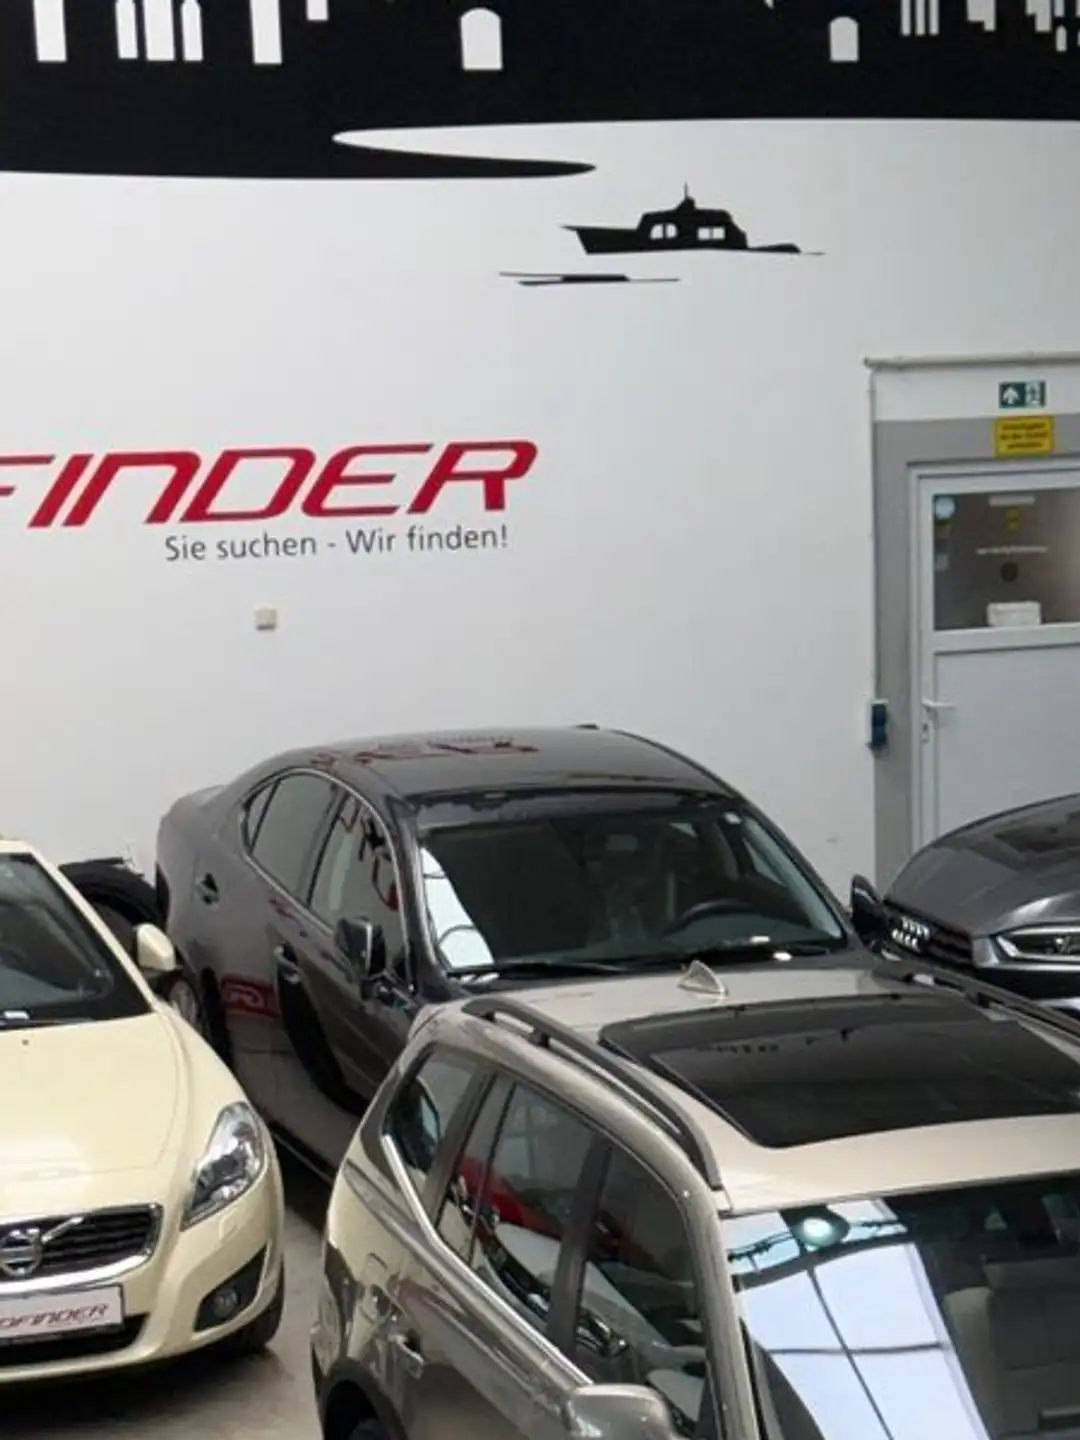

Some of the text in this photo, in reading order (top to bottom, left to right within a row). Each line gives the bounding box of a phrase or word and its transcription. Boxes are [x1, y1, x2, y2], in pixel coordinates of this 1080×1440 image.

[165, 535, 206, 562] Sie
[217, 533, 316, 559] suchen
[345, 529, 397, 555] Wir
[406, 524, 508, 551] finden!
